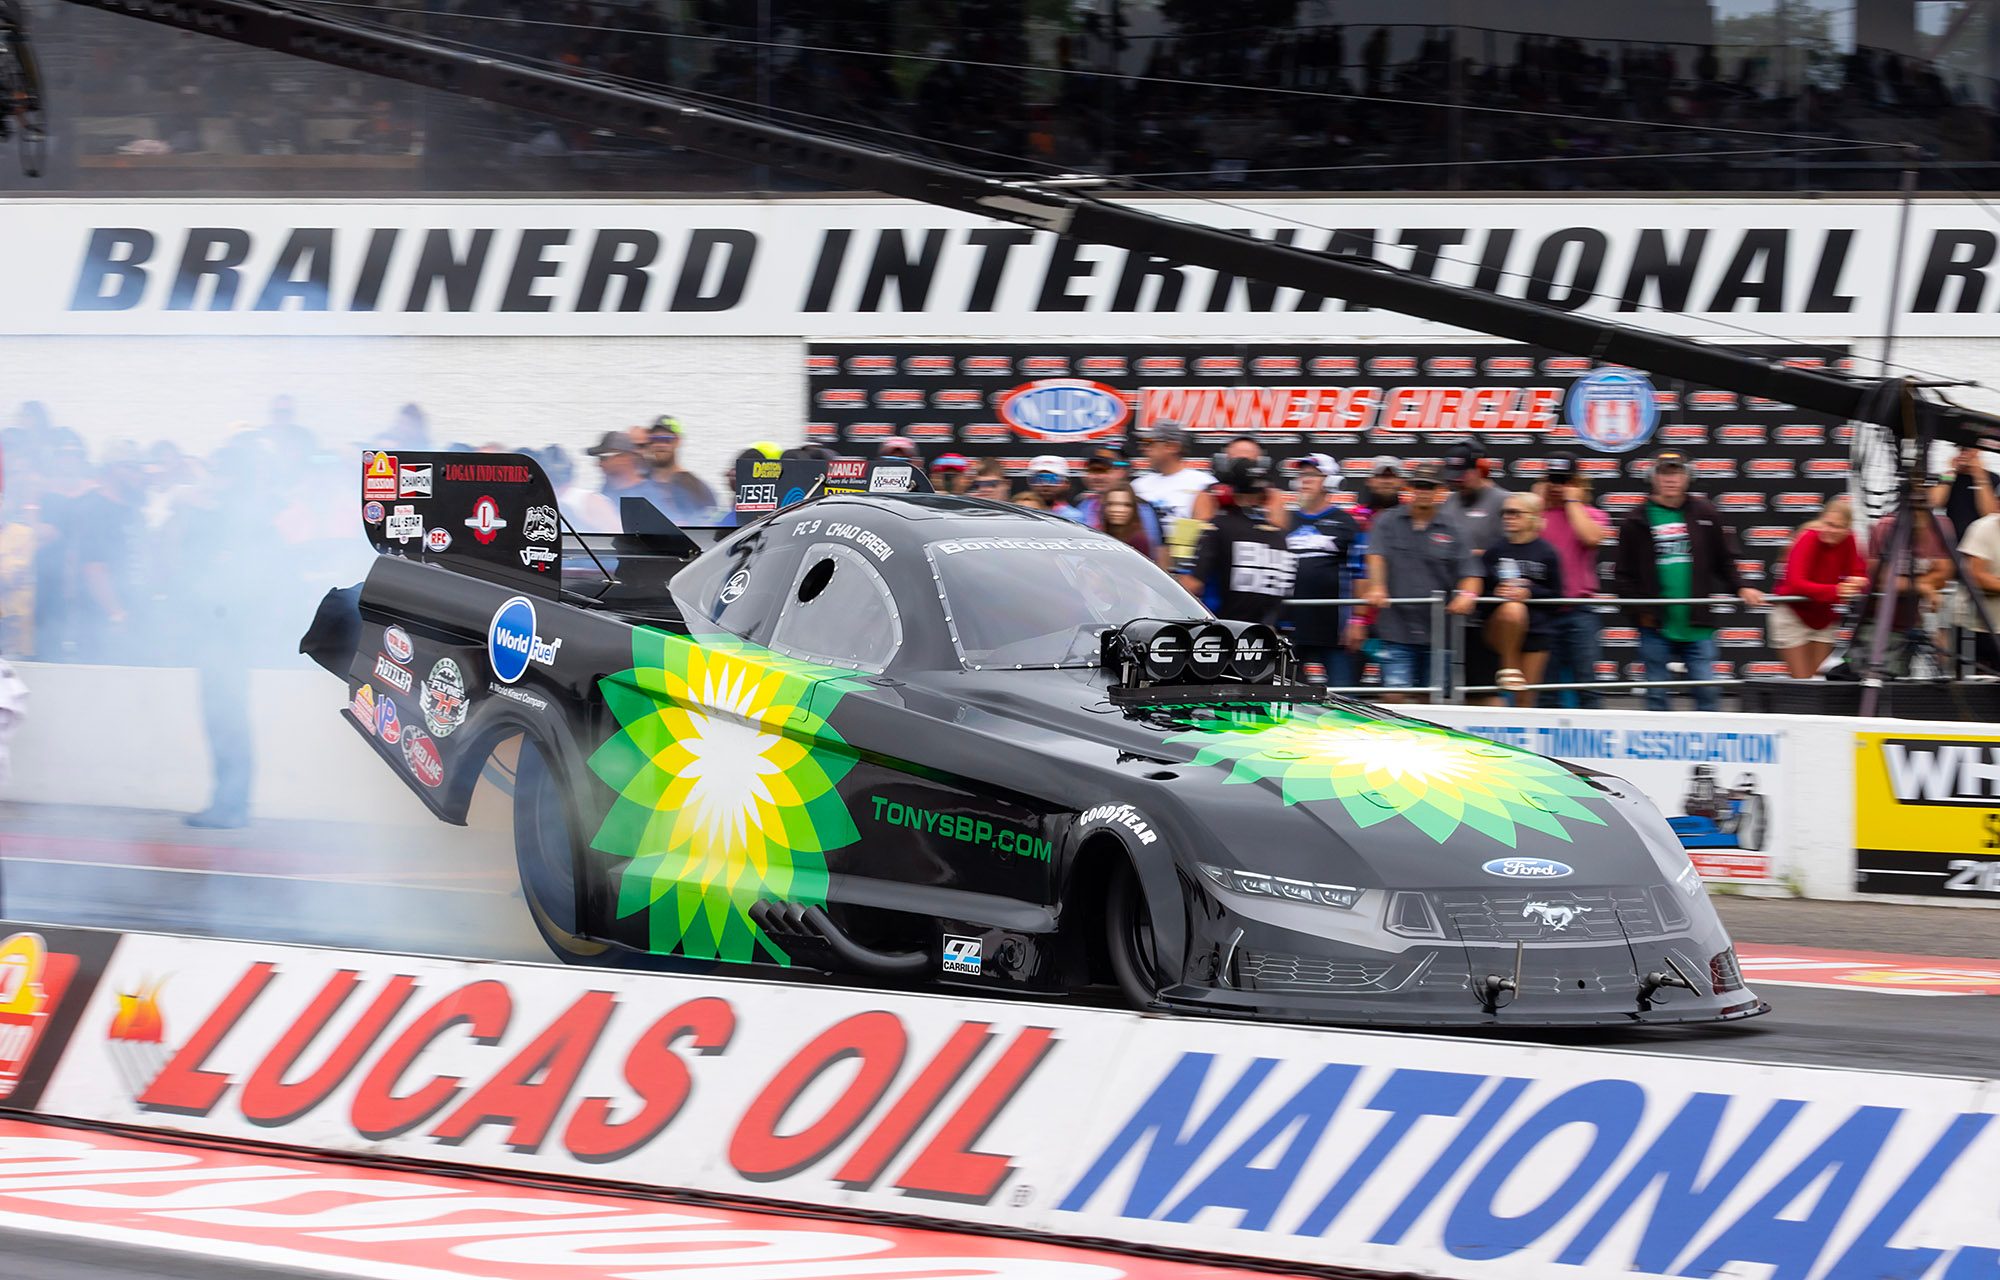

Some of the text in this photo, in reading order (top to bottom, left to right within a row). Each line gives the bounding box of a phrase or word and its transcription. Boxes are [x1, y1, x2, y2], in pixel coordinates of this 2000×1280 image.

[70, 228, 757, 312] BRAINERD
[1905, 228, 2000, 313] R
[1013, 388, 1114, 428] NHRA
[1142, 389, 1378, 429] WINNERS
[1384, 389, 1563, 429] CIRCLE
[401, 475, 431, 487] CHAMPION
[445, 464, 529, 483] LOGAN INDUSTRIES
[827, 463, 865, 477] MANLEY
[367, 478, 395, 489] MISSION
[737, 484, 778, 504] JESEL
[482, 506, 491, 528] L
[792, 520, 821, 536] FC 9
[430, 533, 447, 544] RFC
[825, 523, 894, 562] CHAD GREEN
[937, 541, 1134, 554] Bondcoat.com
[496, 626, 561, 665] World Fuel
[431, 680, 461, 698] FLYING
[522, 692, 548, 710] Company
[378, 694, 397, 733] VP
[1537, 727, 1615, 758] TIMING
[1620, 730, 1781, 763] ASSOCIATION
[412, 741, 427, 760] RED
[425, 752, 442, 780] LINE
[872, 796, 1052, 863] TONYSBP.COM
[1080, 803, 1158, 846] GOODYEAR
[1503, 859, 1557, 876] Ford
[944, 939, 981, 962] CP
[943, 960, 980, 974] CARRILLO
[138, 960, 1064, 1206] LUCAS OIL
[1057, 1050, 2000, 1280] NATIONAL
